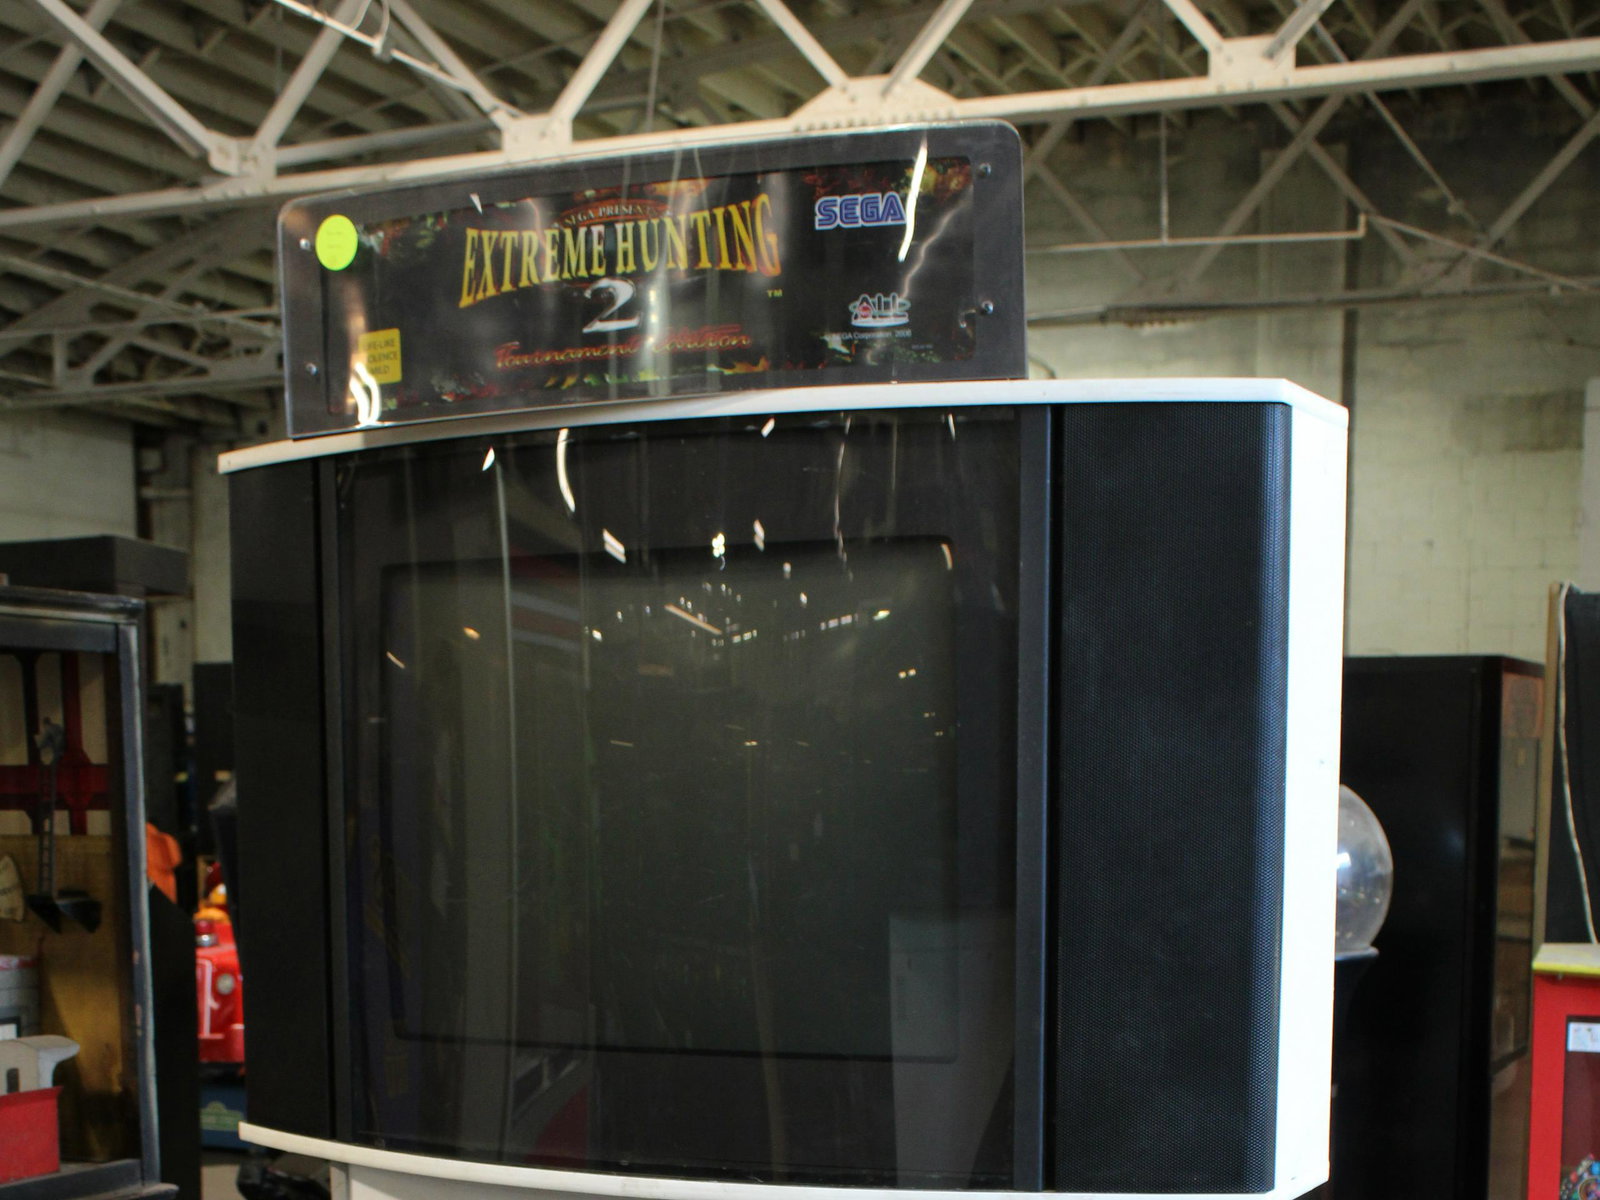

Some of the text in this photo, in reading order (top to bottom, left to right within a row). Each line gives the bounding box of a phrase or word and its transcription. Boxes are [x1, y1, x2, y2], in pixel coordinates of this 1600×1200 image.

[815, 191, 908, 231] SEGA
[458, 192, 783, 309] EXTREME HUNTING
[582, 277, 644, 334] 2
